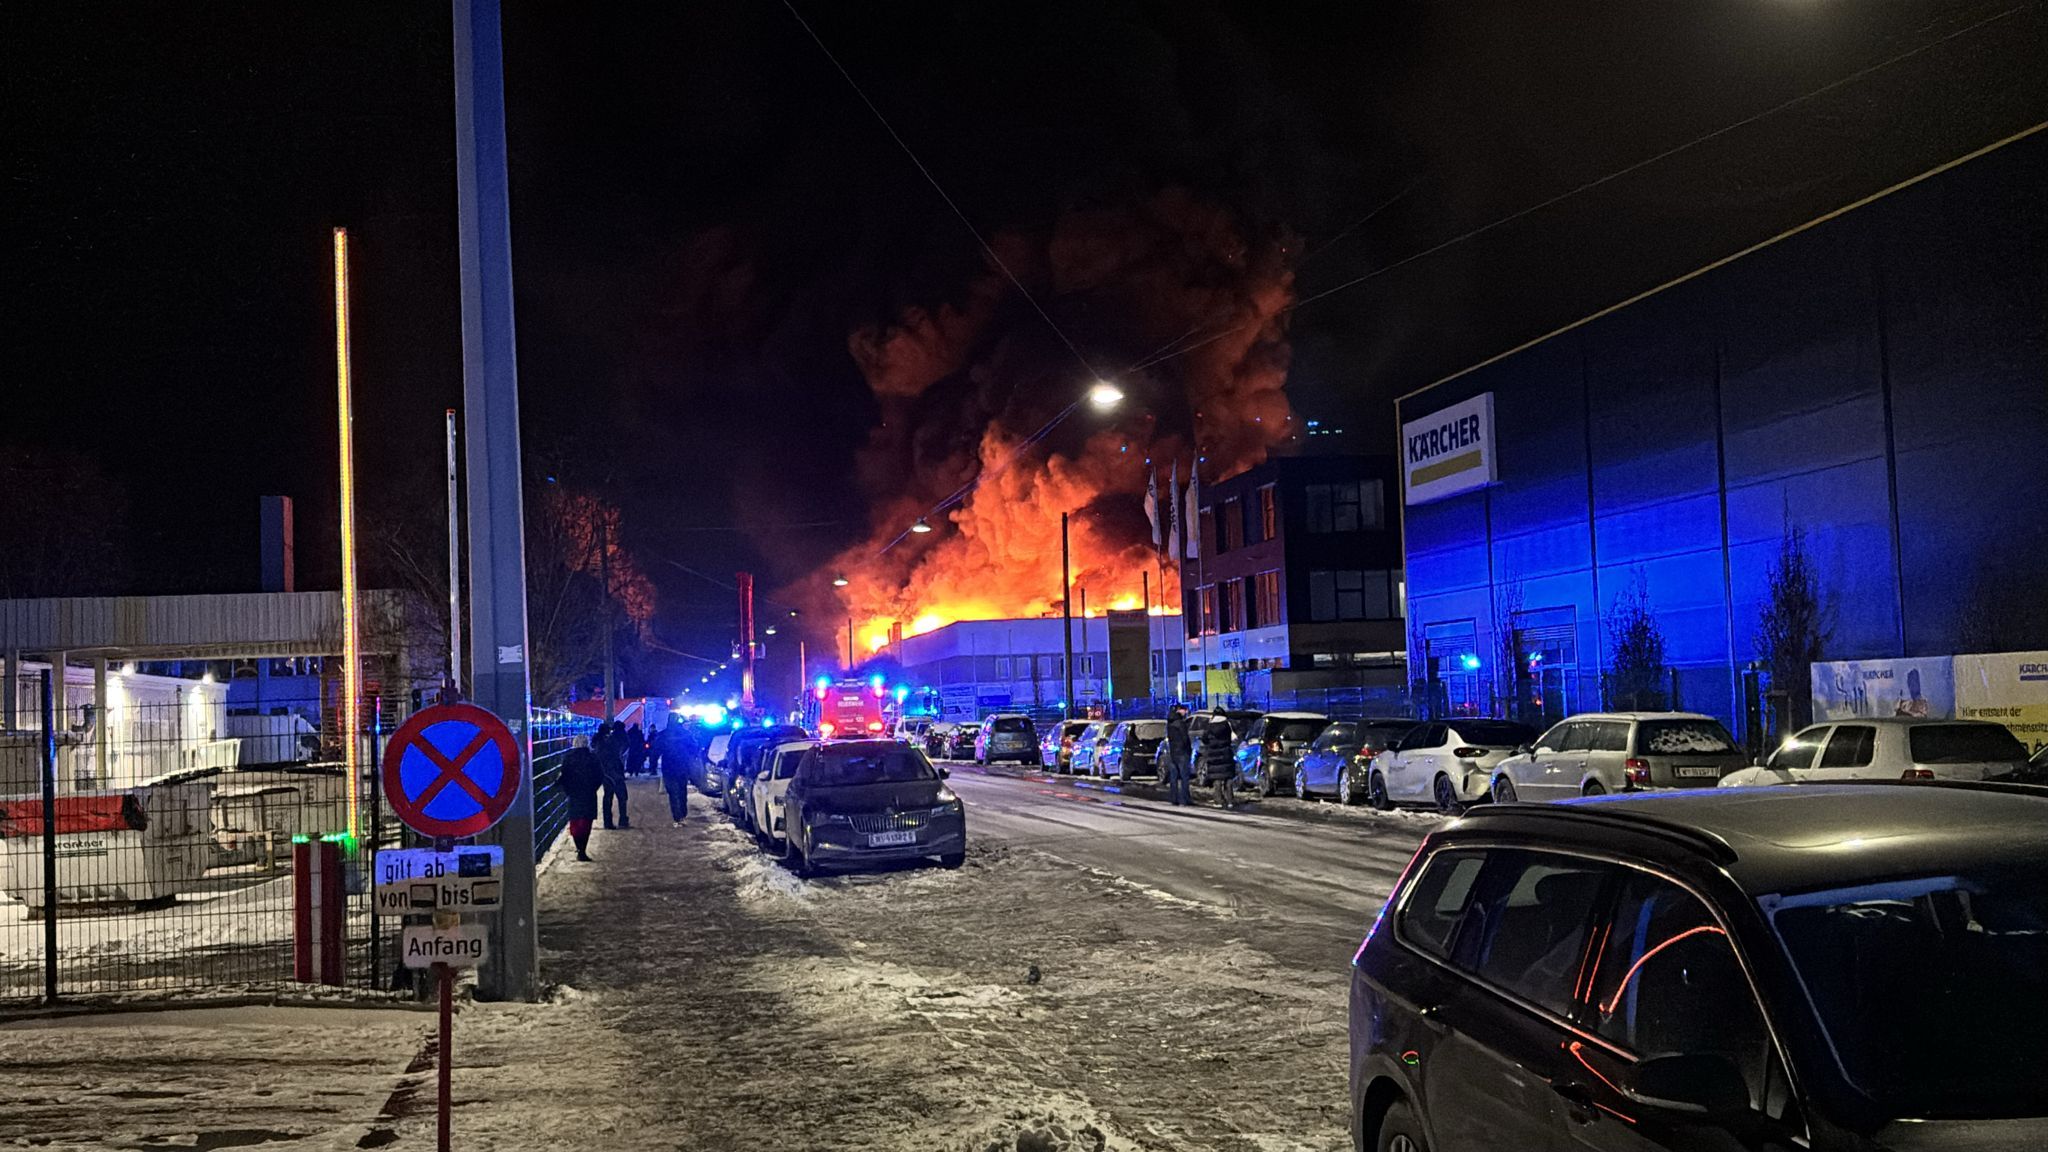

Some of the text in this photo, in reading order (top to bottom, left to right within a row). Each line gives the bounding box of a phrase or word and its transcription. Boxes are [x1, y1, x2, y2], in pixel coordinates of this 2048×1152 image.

[1409, 414, 1480, 463] KÄRCHER
[2009, 706, 2022, 717] der
[385, 858, 445, 885] gilt ab
[380, 885, 469, 908] von bis
[408, 936, 482, 958] Anfang
